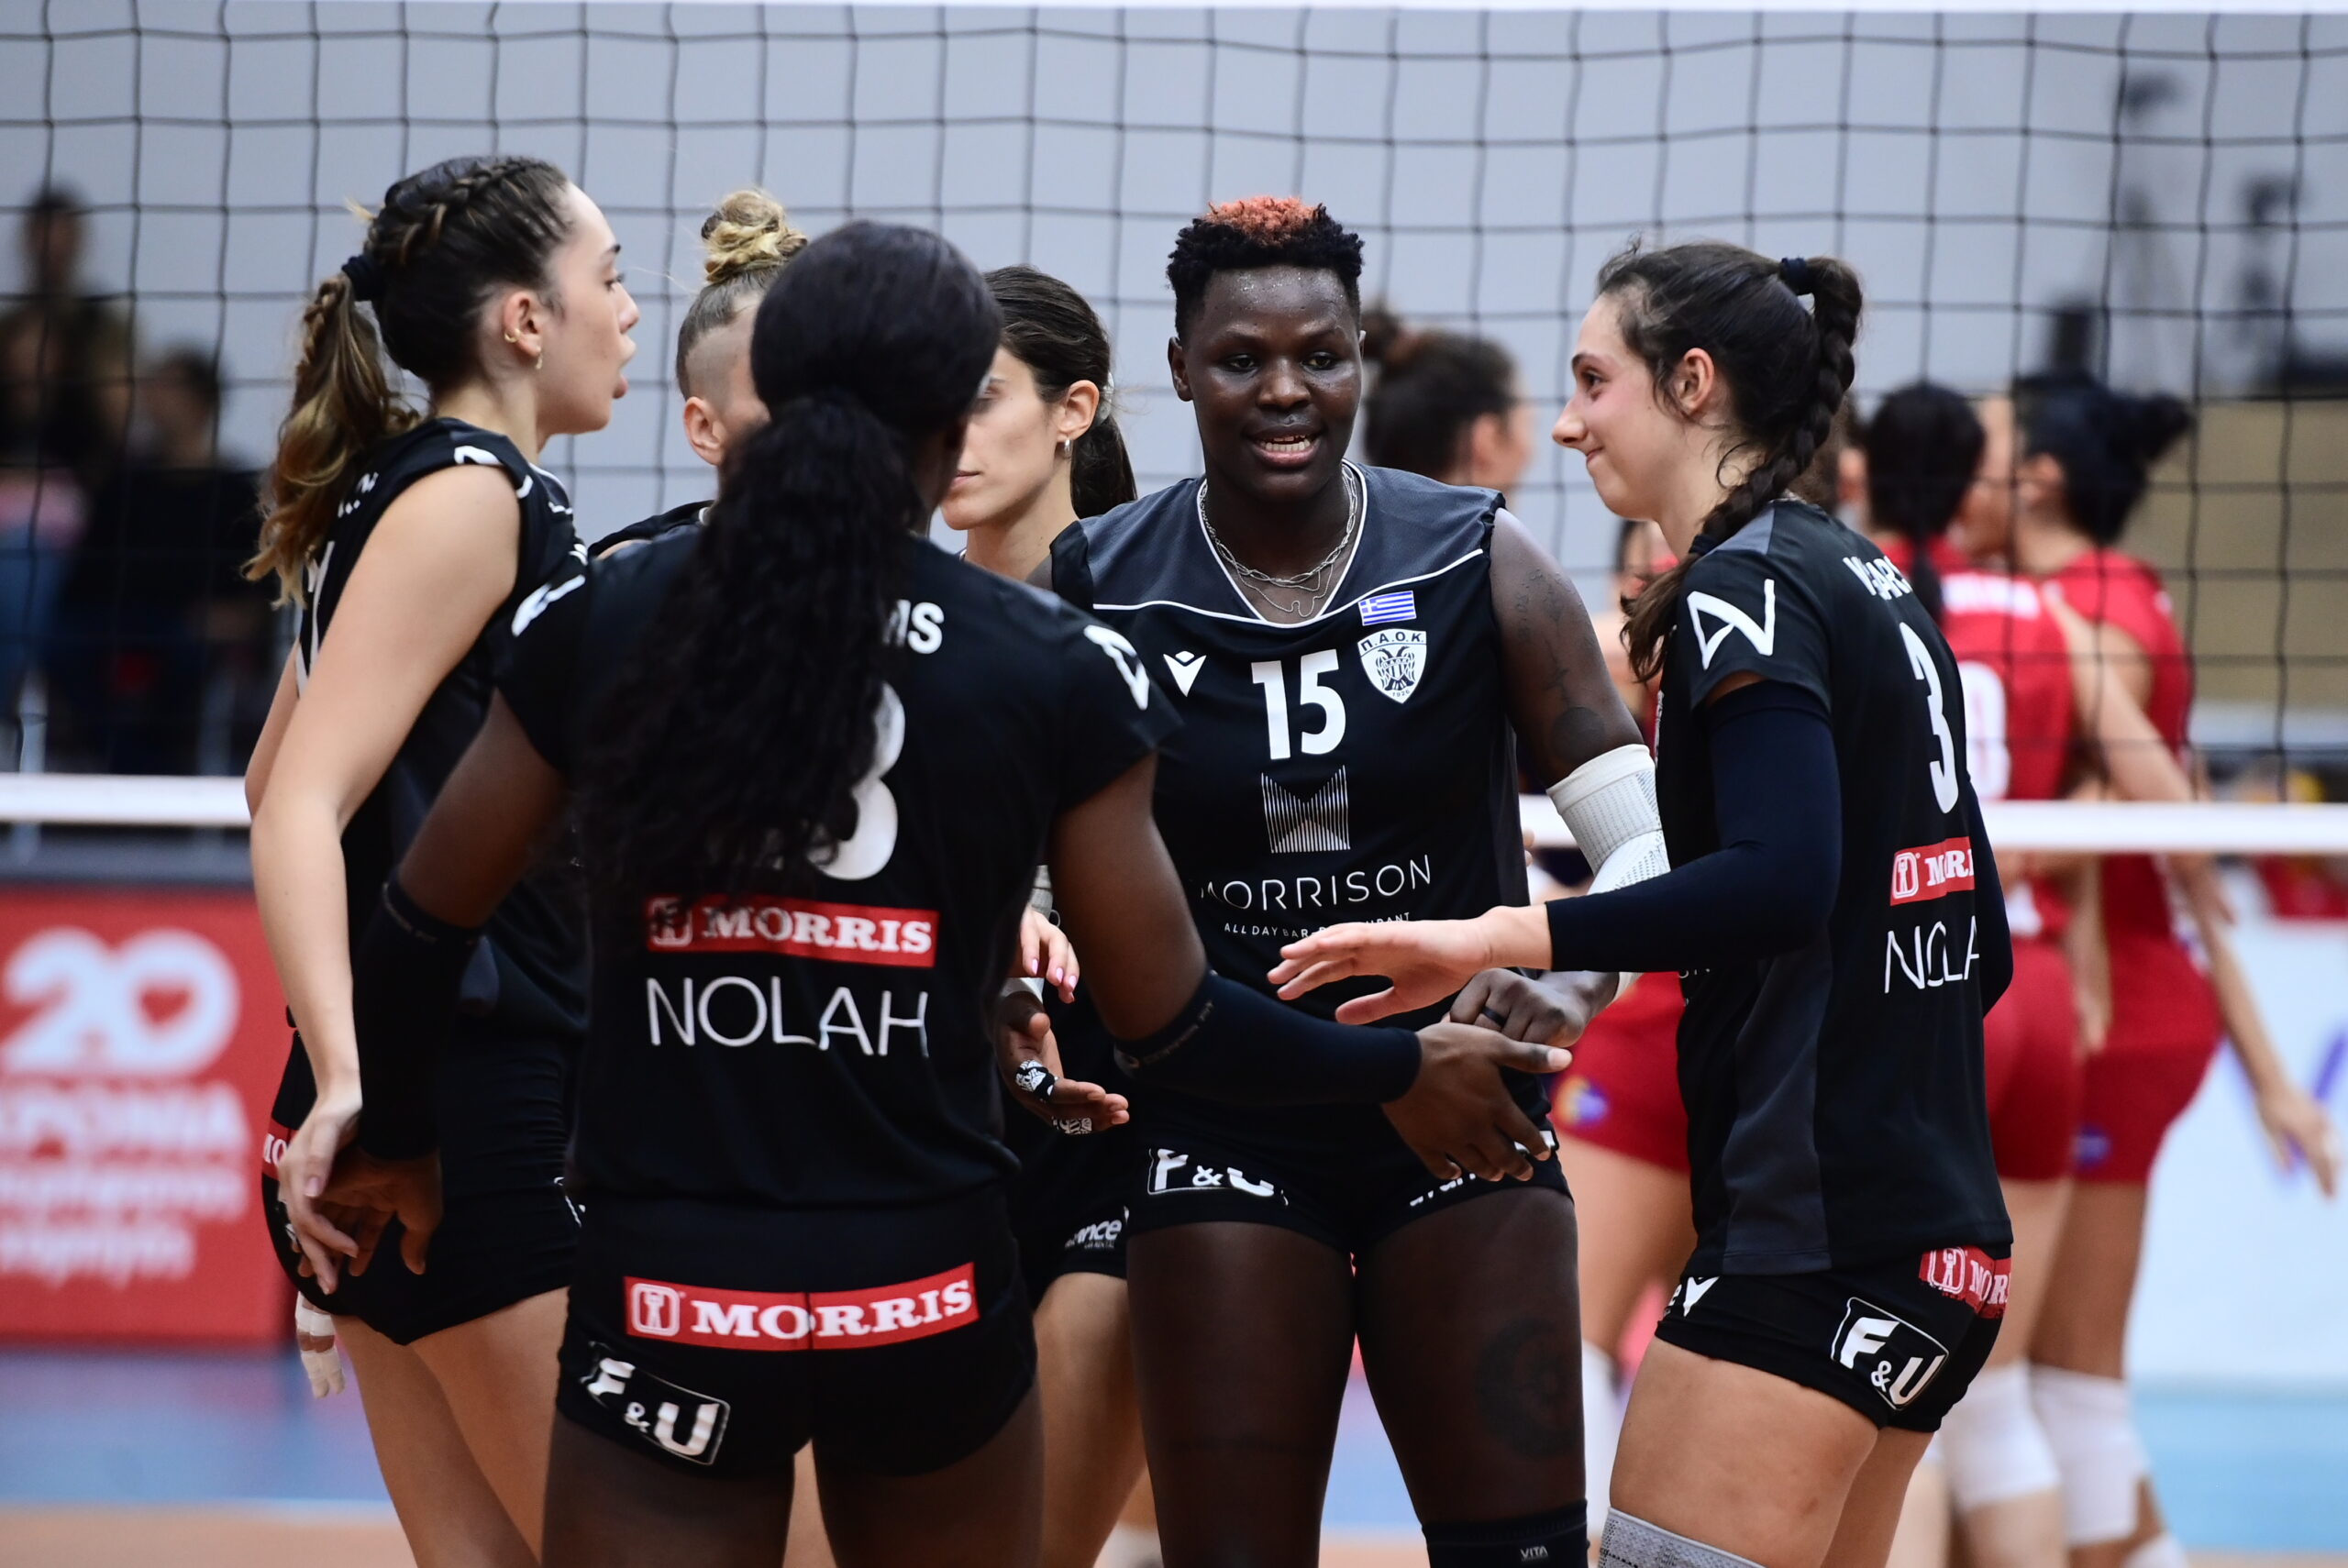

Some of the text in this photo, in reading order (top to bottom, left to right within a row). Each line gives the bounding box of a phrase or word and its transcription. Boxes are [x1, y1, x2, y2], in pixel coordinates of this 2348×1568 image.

[1251, 648, 1346, 760] 15
[1899, 622, 1959, 813] 3
[702, 906, 932, 955] MORRIS
[1224, 922, 1247, 934] ALL
[1252, 925, 1278, 936] DAY
[647, 975, 930, 1058] NOLAH
[690, 1279, 972, 1339] MORRIS
[1840, 1317, 1945, 1405] F&U
